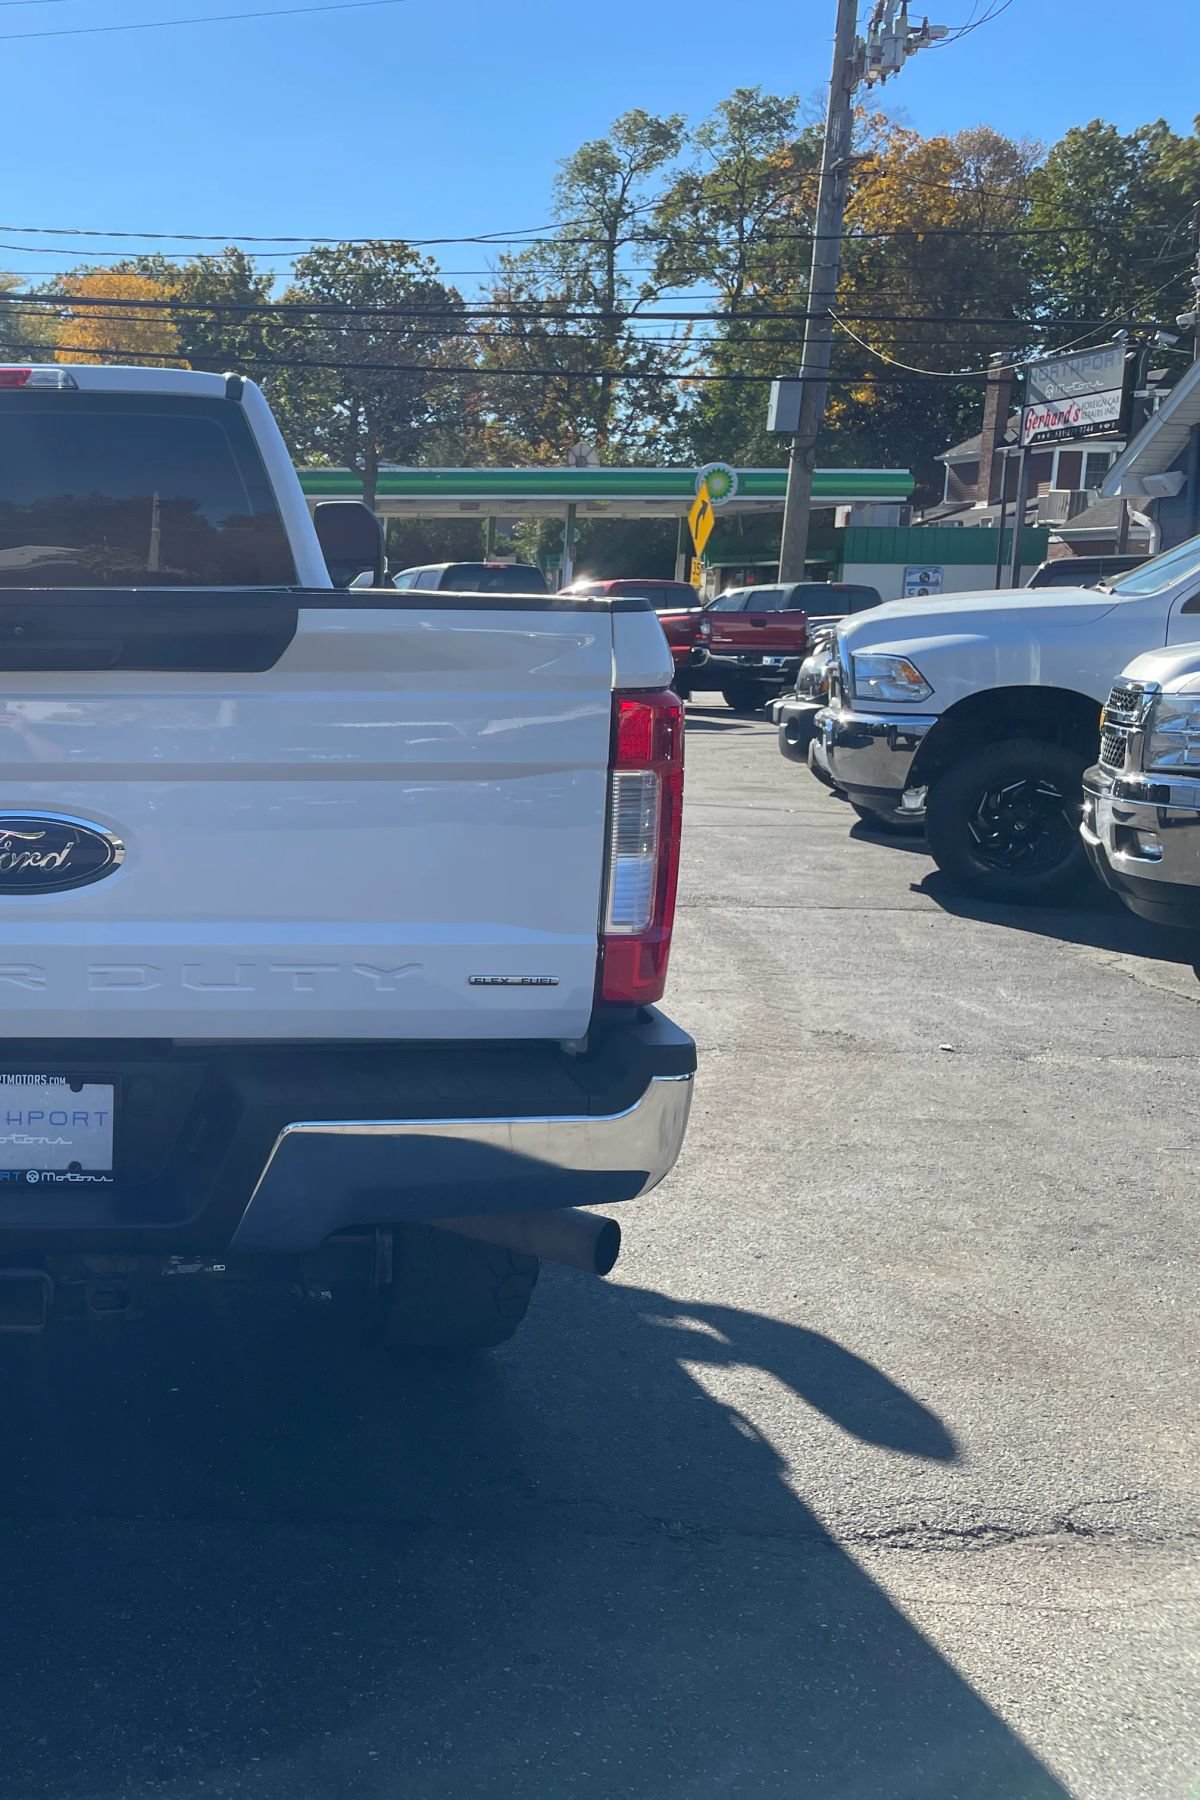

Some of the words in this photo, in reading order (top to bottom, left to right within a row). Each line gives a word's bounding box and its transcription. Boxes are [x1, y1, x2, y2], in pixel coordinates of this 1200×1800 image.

[1025, 402, 1081, 438] Gerhard's
[692, 560, 701, 576] 35
[88, 963, 423, 991] DUTY
[474, 977, 509, 985] FLEX
[521, 977, 554, 985] FUEL
[41, 1172, 114, 1183] Motors
